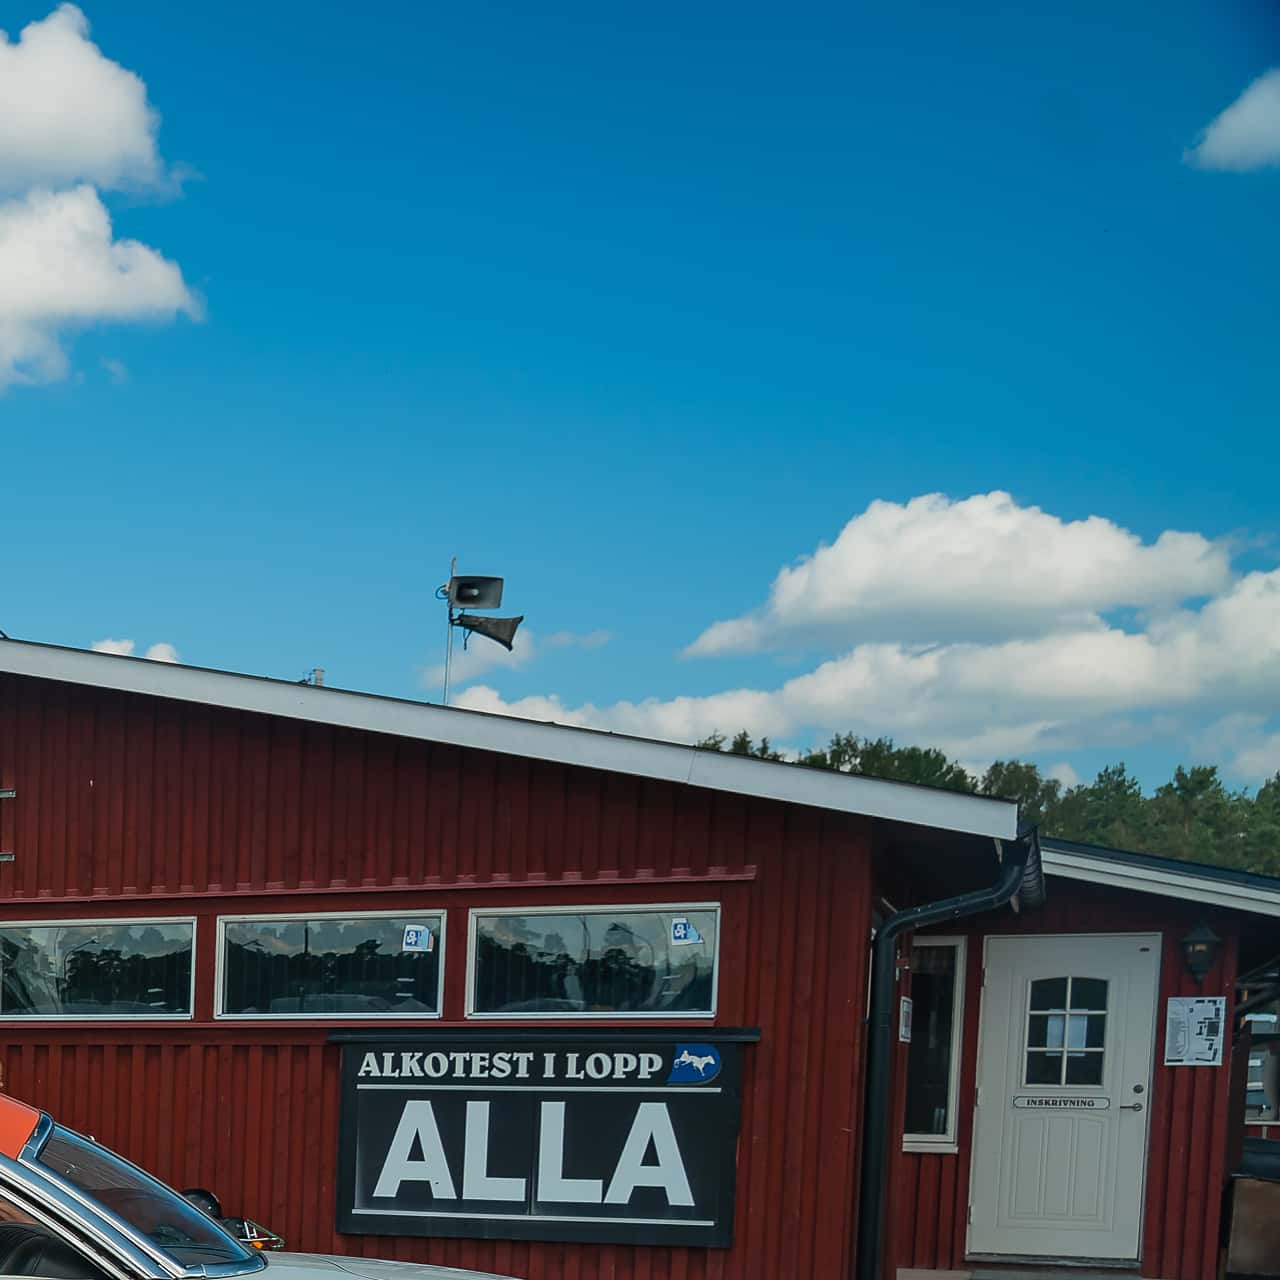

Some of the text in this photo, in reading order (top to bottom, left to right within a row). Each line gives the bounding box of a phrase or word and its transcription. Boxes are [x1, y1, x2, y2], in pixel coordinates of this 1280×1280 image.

[357, 1052, 663, 1080] ALKOTEST I LOPP
[1025, 1098, 1096, 1107] INSKRIVNING
[372, 1100, 695, 1206] ALLA
